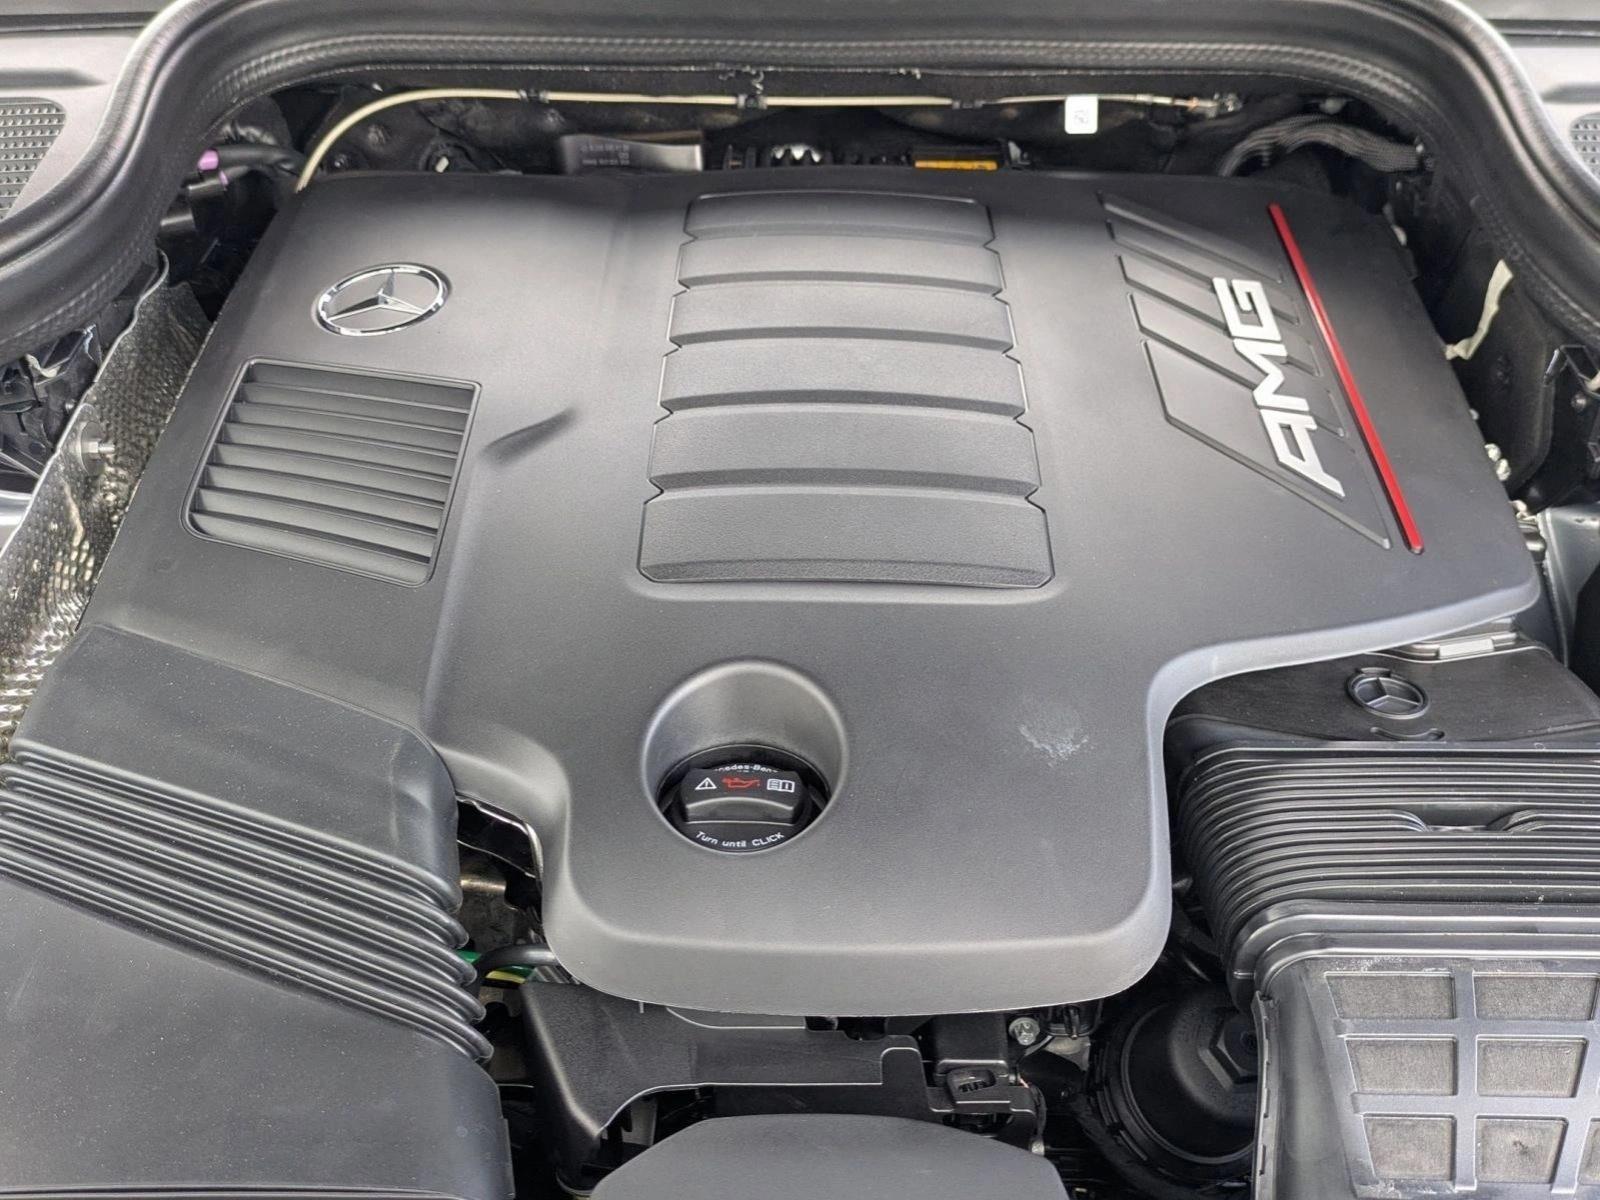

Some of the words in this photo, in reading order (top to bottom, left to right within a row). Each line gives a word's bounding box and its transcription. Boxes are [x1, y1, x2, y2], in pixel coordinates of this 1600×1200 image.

[1212, 276, 1345, 497] AMG
[696, 830, 719, 845] Turn
[722, 839, 747, 848] until
[751, 831, 785, 847] CLICK
